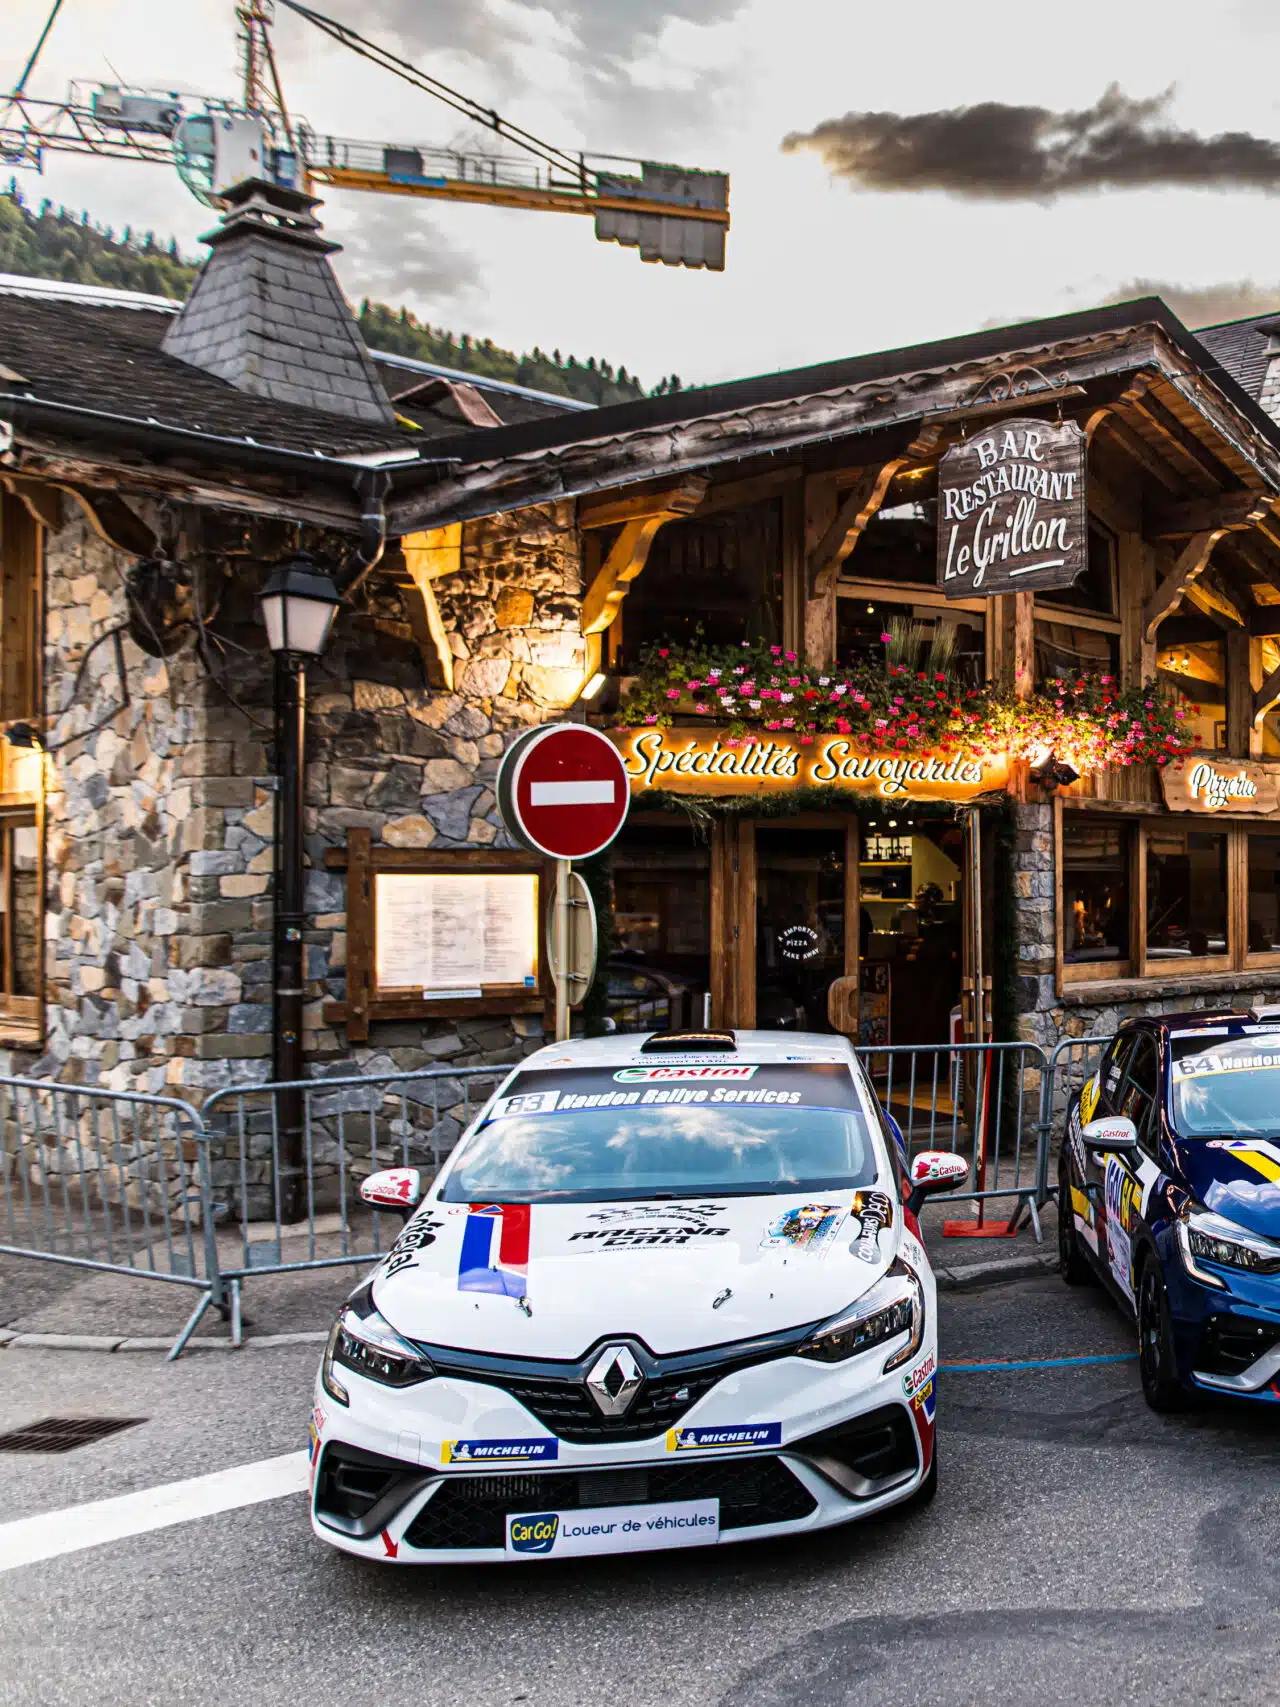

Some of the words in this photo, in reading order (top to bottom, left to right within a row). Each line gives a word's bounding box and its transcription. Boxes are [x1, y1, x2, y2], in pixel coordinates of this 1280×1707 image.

[974, 430, 1045, 470] BAR
[943, 464, 1077, 521] RESTAURANT
[944, 523, 970, 581] Le
[972, 497, 1074, 588] Grillon
[625, 732, 801, 784] Spécialités
[811, 740, 985, 794] Savoyardes
[1191, 763, 1258, 807] Pizzeria
[783, 926, 818, 940] EMPORTER
[786, 939, 808, 947] PIZZA
[783, 949, 800, 960] TAKE
[803, 948, 819, 960] AWAY
[649, 1066, 751, 1080] Castrol
[1178, 1057, 1215, 1076] 64
[503, 1094, 544, 1114] 83
[557, 1090, 640, 1110] Naudon
[641, 1088, 710, 1105] Rallye
[712, 1087, 802, 1104] Services
[1102, 1130, 1130, 1138] Castrol
[568, 1227, 731, 1241] RACING
[602, 1236, 691, 1247] CAR
[912, 1352, 935, 1388] Castrol
[700, 1430, 769, 1443] MICHELIN
[474, 1445, 545, 1457] MICHELIN
[563, 1522, 618, 1538] Loueur
[622, 1519, 642, 1533] de
[646, 1513, 716, 1531] véhicules
